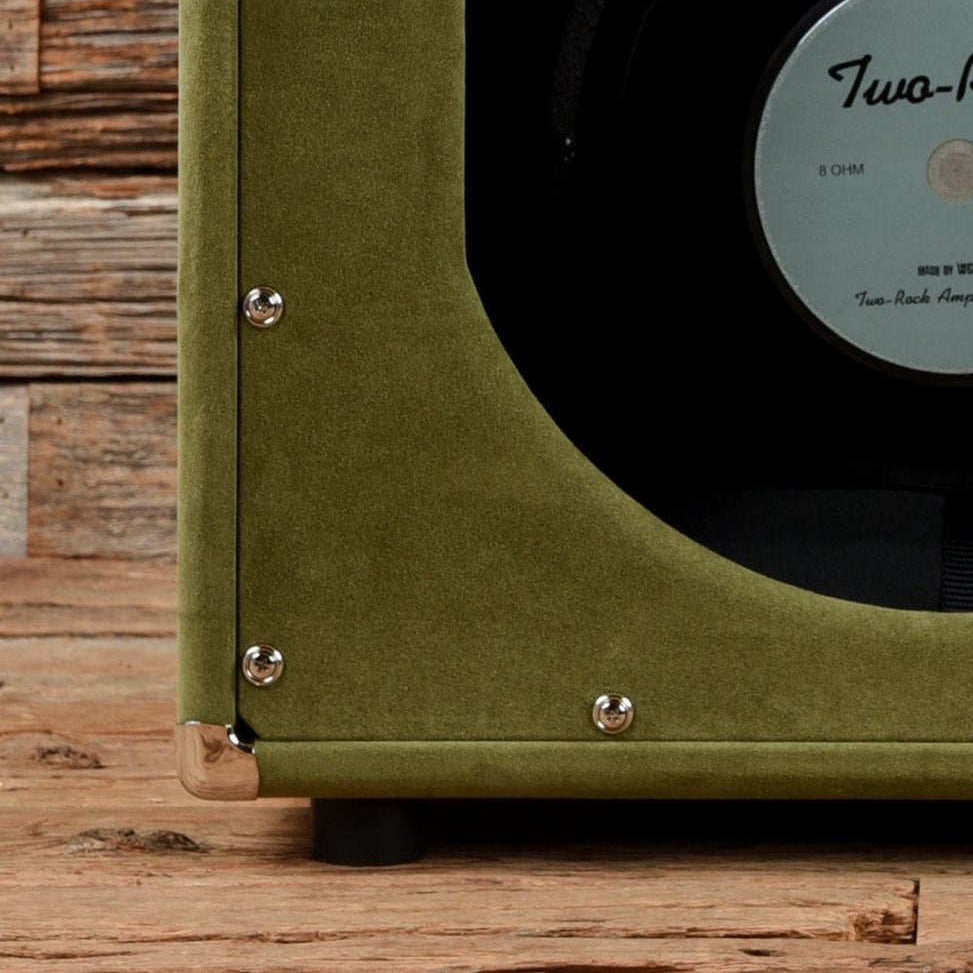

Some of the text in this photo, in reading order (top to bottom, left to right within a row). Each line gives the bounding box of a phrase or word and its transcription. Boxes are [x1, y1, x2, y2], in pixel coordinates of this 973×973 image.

[818, 164, 865, 177] 8 OHM
[854, 292, 931, 308] Two-Rock
